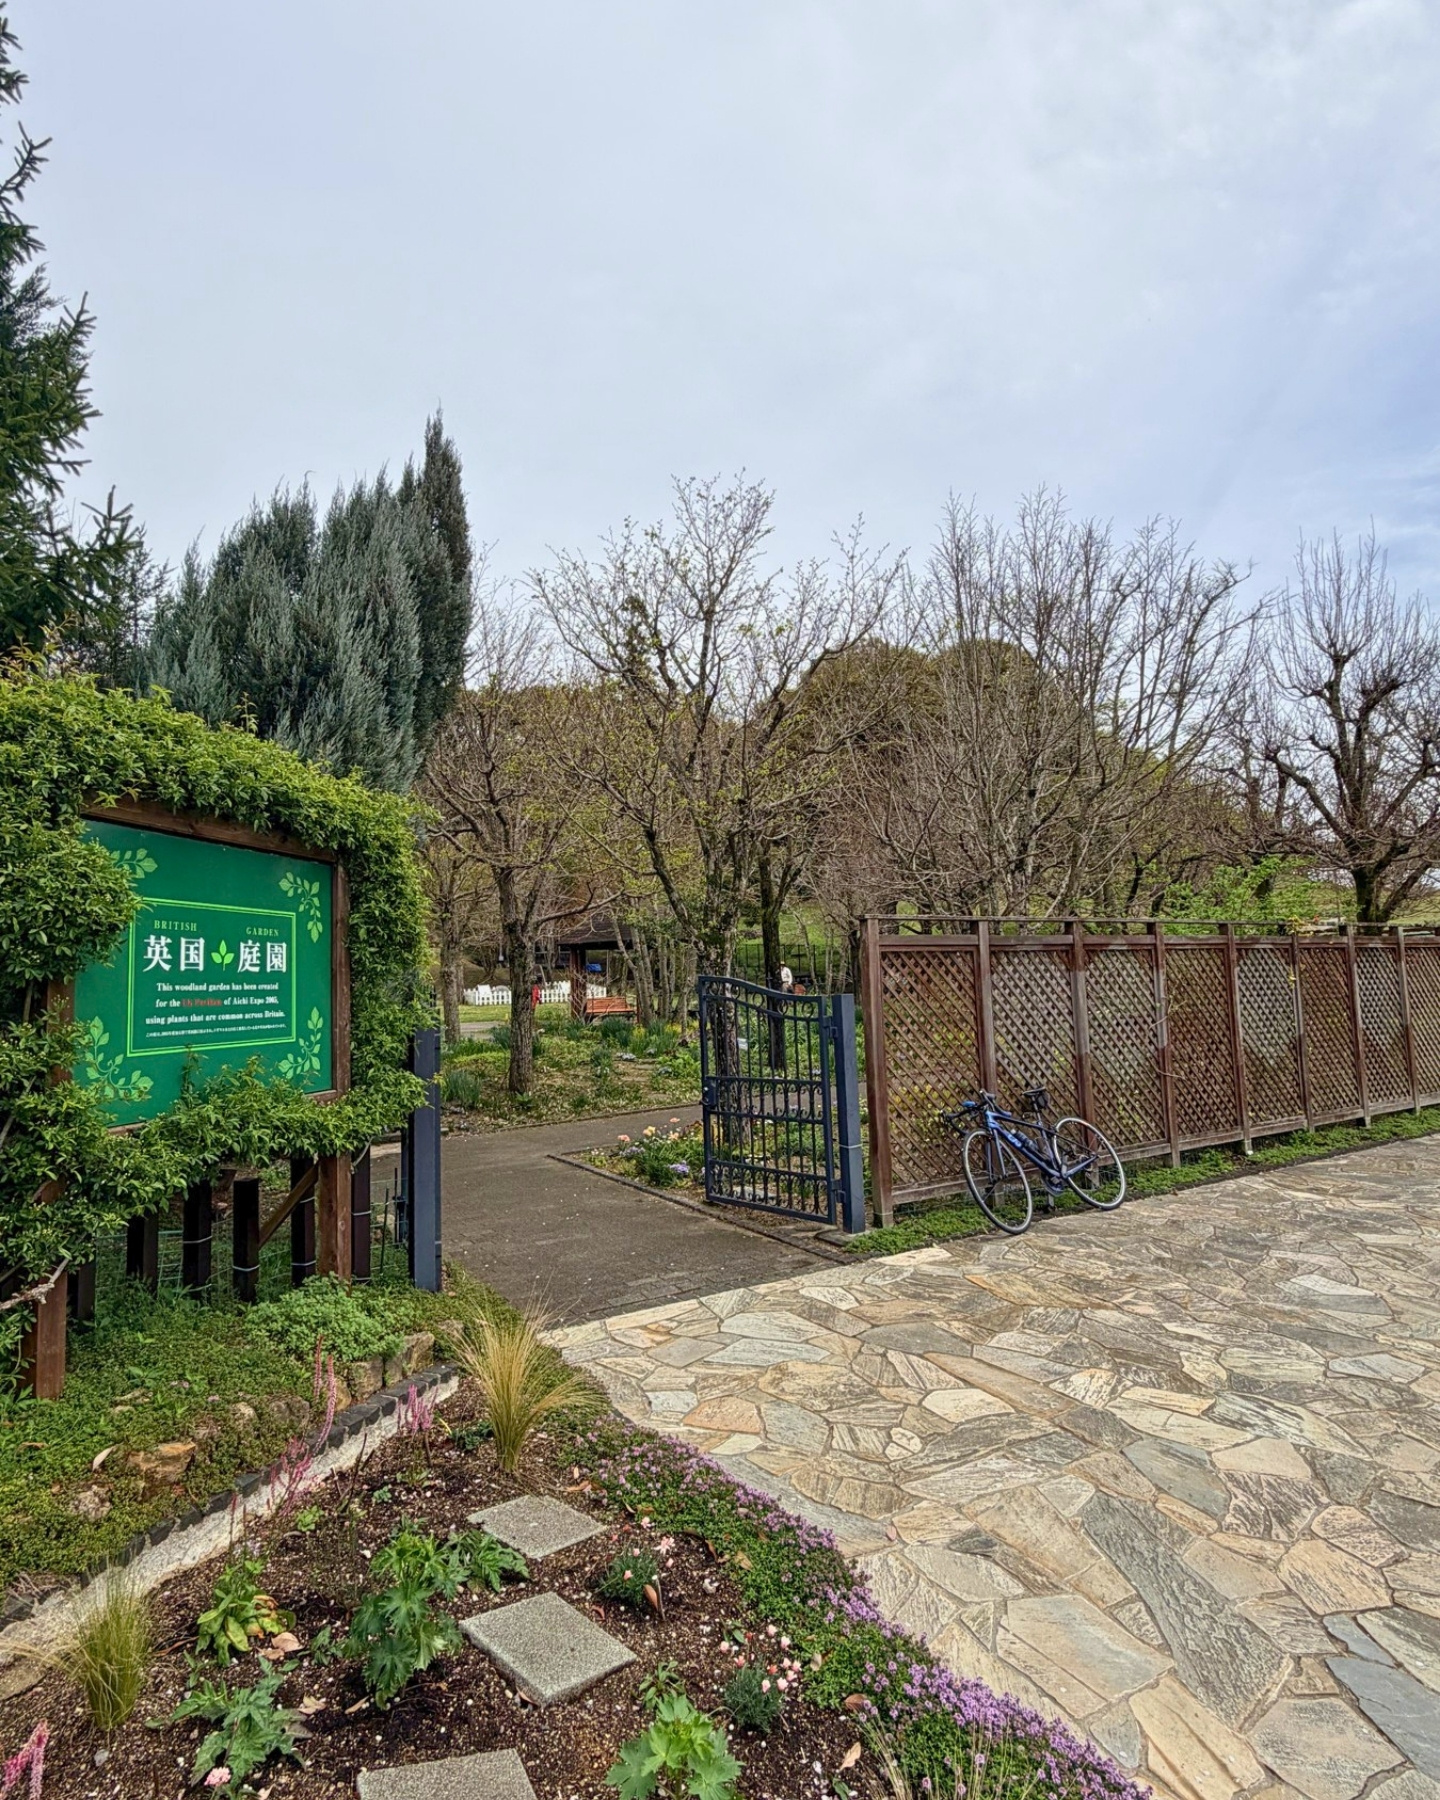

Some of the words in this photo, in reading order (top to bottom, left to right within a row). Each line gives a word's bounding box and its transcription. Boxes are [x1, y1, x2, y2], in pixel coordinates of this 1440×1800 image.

[154, 920, 198, 932] BRITISH
[246, 927, 279, 937] GARDEN
[142, 935, 205, 972] 英国
[237, 939, 287, 973] 庭園
[156, 983, 173, 991] This
[175, 983, 207, 991] woodland
[208, 983, 230, 992] garden
[232, 982, 242, 990] has
[155, 999, 168, 1007] for
[169, 999, 181, 1007] the
[224, 997, 231, 1005] of
[232, 997, 248, 1005] Aichi
[250, 996, 264, 1005] Expo
[145, 1015, 166, 1025] using
[167, 1015, 189, 1025] plants
[190, 1014, 204, 1022] that
